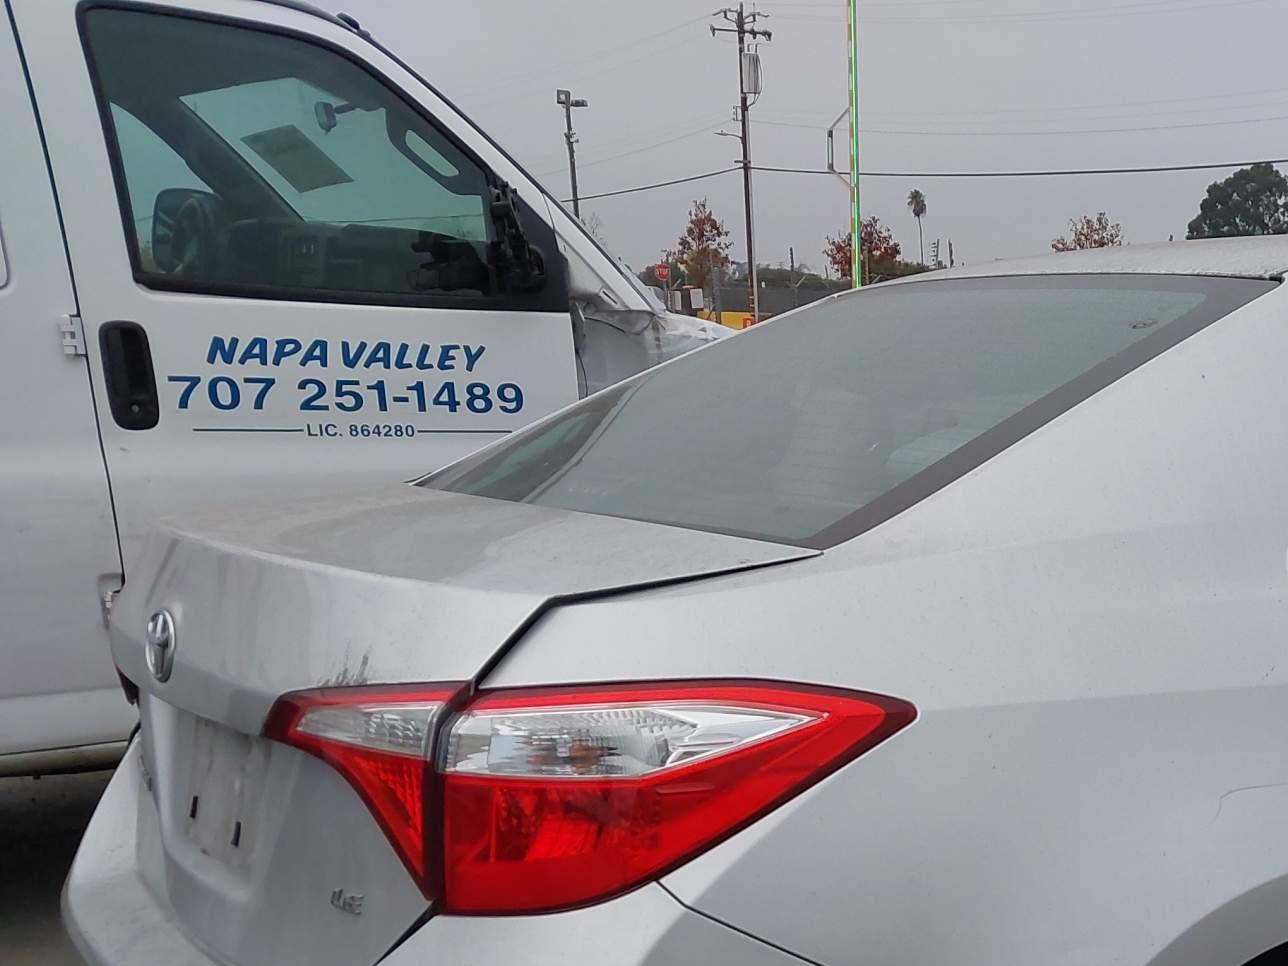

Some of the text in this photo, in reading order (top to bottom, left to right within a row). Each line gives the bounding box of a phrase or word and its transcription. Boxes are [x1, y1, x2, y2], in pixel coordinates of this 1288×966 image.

[206, 335, 486, 373] NAPA VALLEY
[167, 375, 524, 415] 707 251-1489
[306, 423, 416, 438] LIC. 864280
